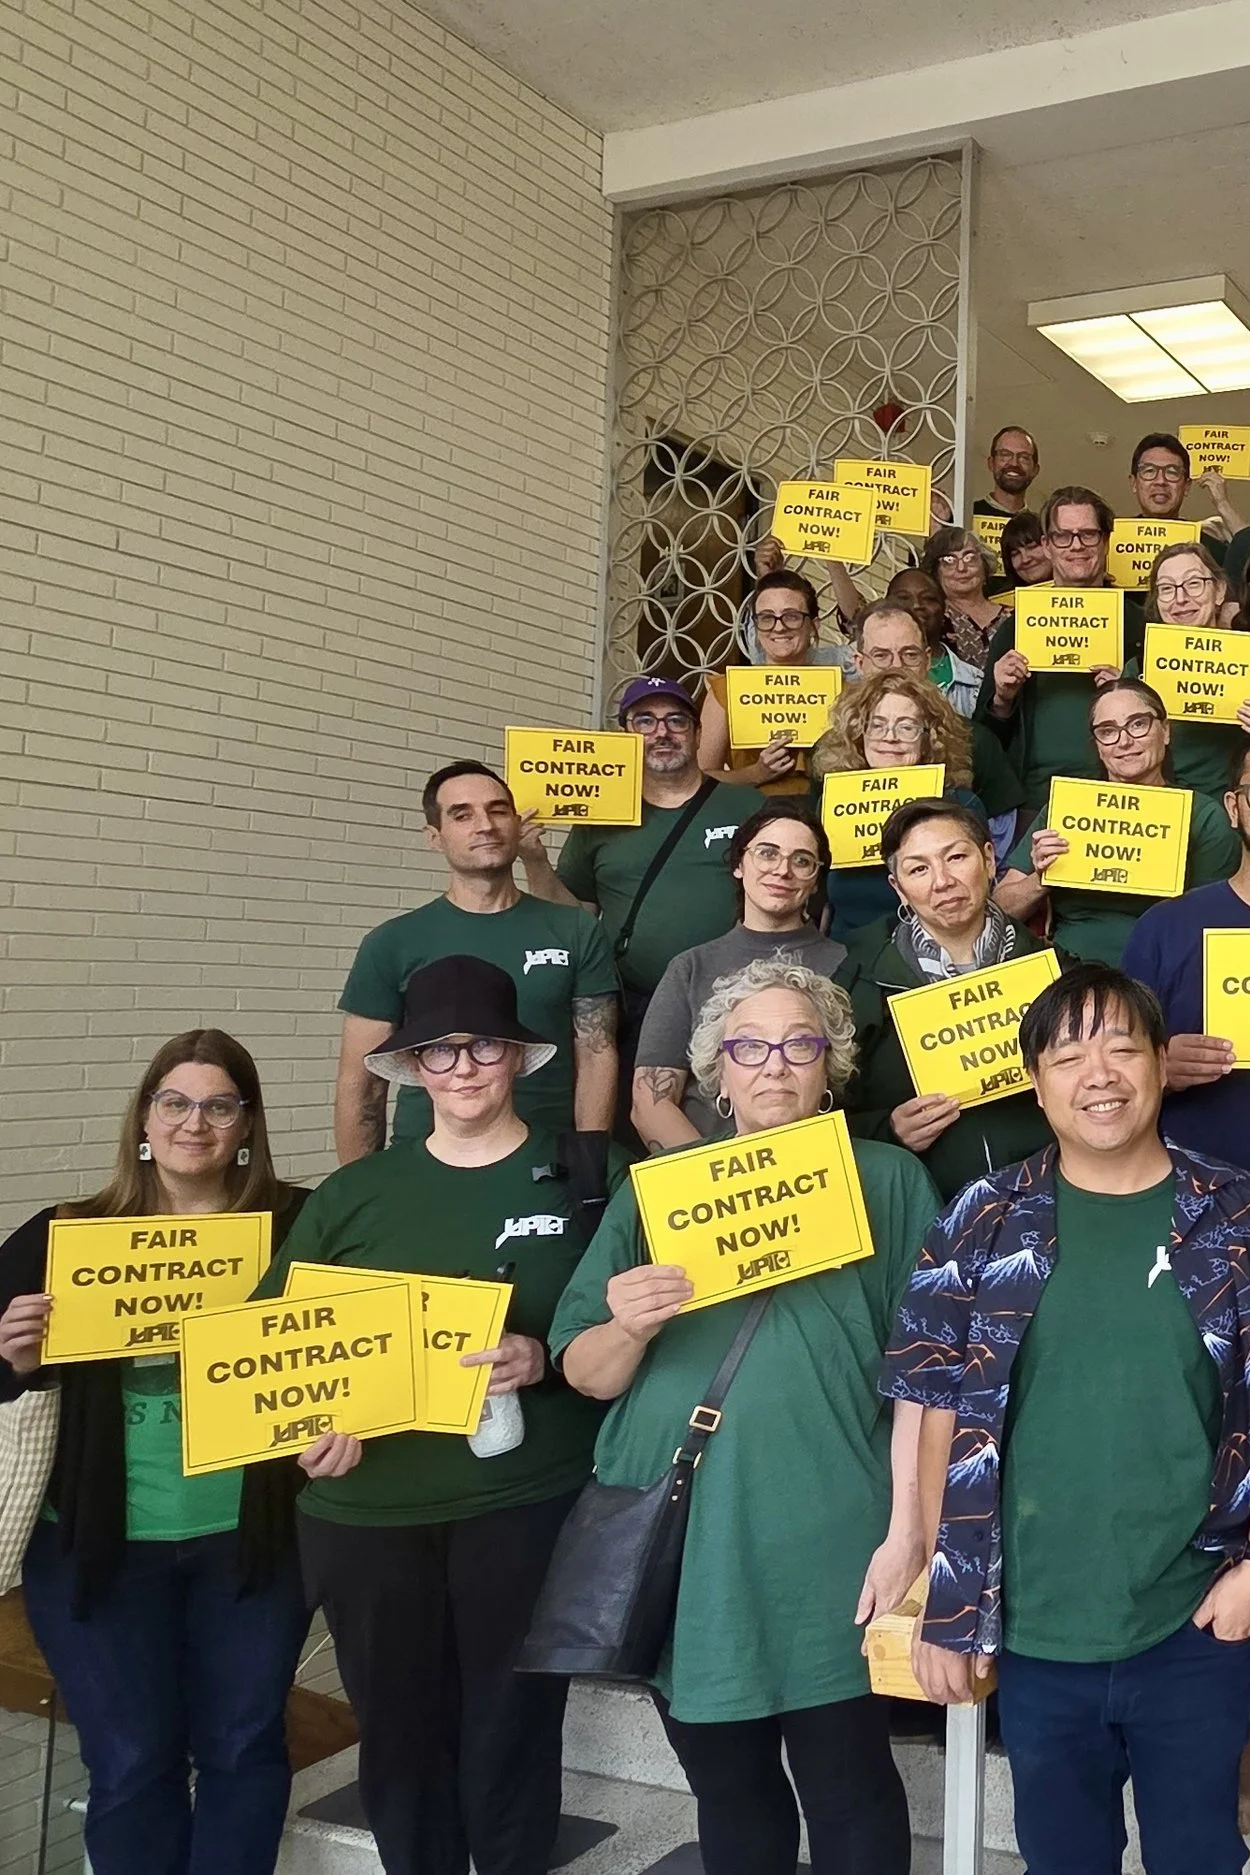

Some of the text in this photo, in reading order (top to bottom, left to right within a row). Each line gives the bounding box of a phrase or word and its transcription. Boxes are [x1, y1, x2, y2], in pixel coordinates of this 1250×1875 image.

[1204, 430, 1229, 439] FAIR
[1186, 442, 1246, 451] CONTRACT
[1199, 454, 1231, 462] NOW!
[866, 467, 897, 478] FAIR
[808, 489, 840, 501] FAIR
[783, 504, 862, 523] CONTRACT
[798, 523, 840, 537] NOW!
[1137, 526, 1166, 536] FAIR
[1051, 597, 1084, 608] FAIR
[1026, 616, 1109, 629] CONTRACT
[1045, 636, 1088, 648] NOW!
[1185, 637, 1222, 652] FAIR
[1156, 657, 1249, 676] CONTRACT
[765, 675, 800, 686] FAIR
[1177, 681, 1224, 697] NOW!
[739, 694, 827, 705] CONTRACT
[761, 712, 807, 724] NOW!
[552, 739, 595, 753] FAIR
[519, 760, 625, 777] CONTRACT
[545, 783, 600, 798] NOW!
[862, 777, 898, 792] FAIR
[1097, 793, 1140, 811] FAIR
[1062, 815, 1171, 839] CONTRACT
[1086, 843, 1141, 862] NOW!
[948, 980, 1003, 1010] FAIR
[960, 1038, 1018, 1071] NOW
[709, 1147, 777, 1182] FAIR
[667, 1168, 828, 1231] CONTRACT
[130, 1229, 197, 1250] FAIR
[716, 1213, 801, 1256] NOW!
[71, 1257, 243, 1287] CONTRACT
[114, 1292, 203, 1317] NOW!
[261, 1306, 336, 1337] FAIR
[207, 1333, 392, 1384] CONTRACT
[254, 1376, 351, 1414] NOW!
